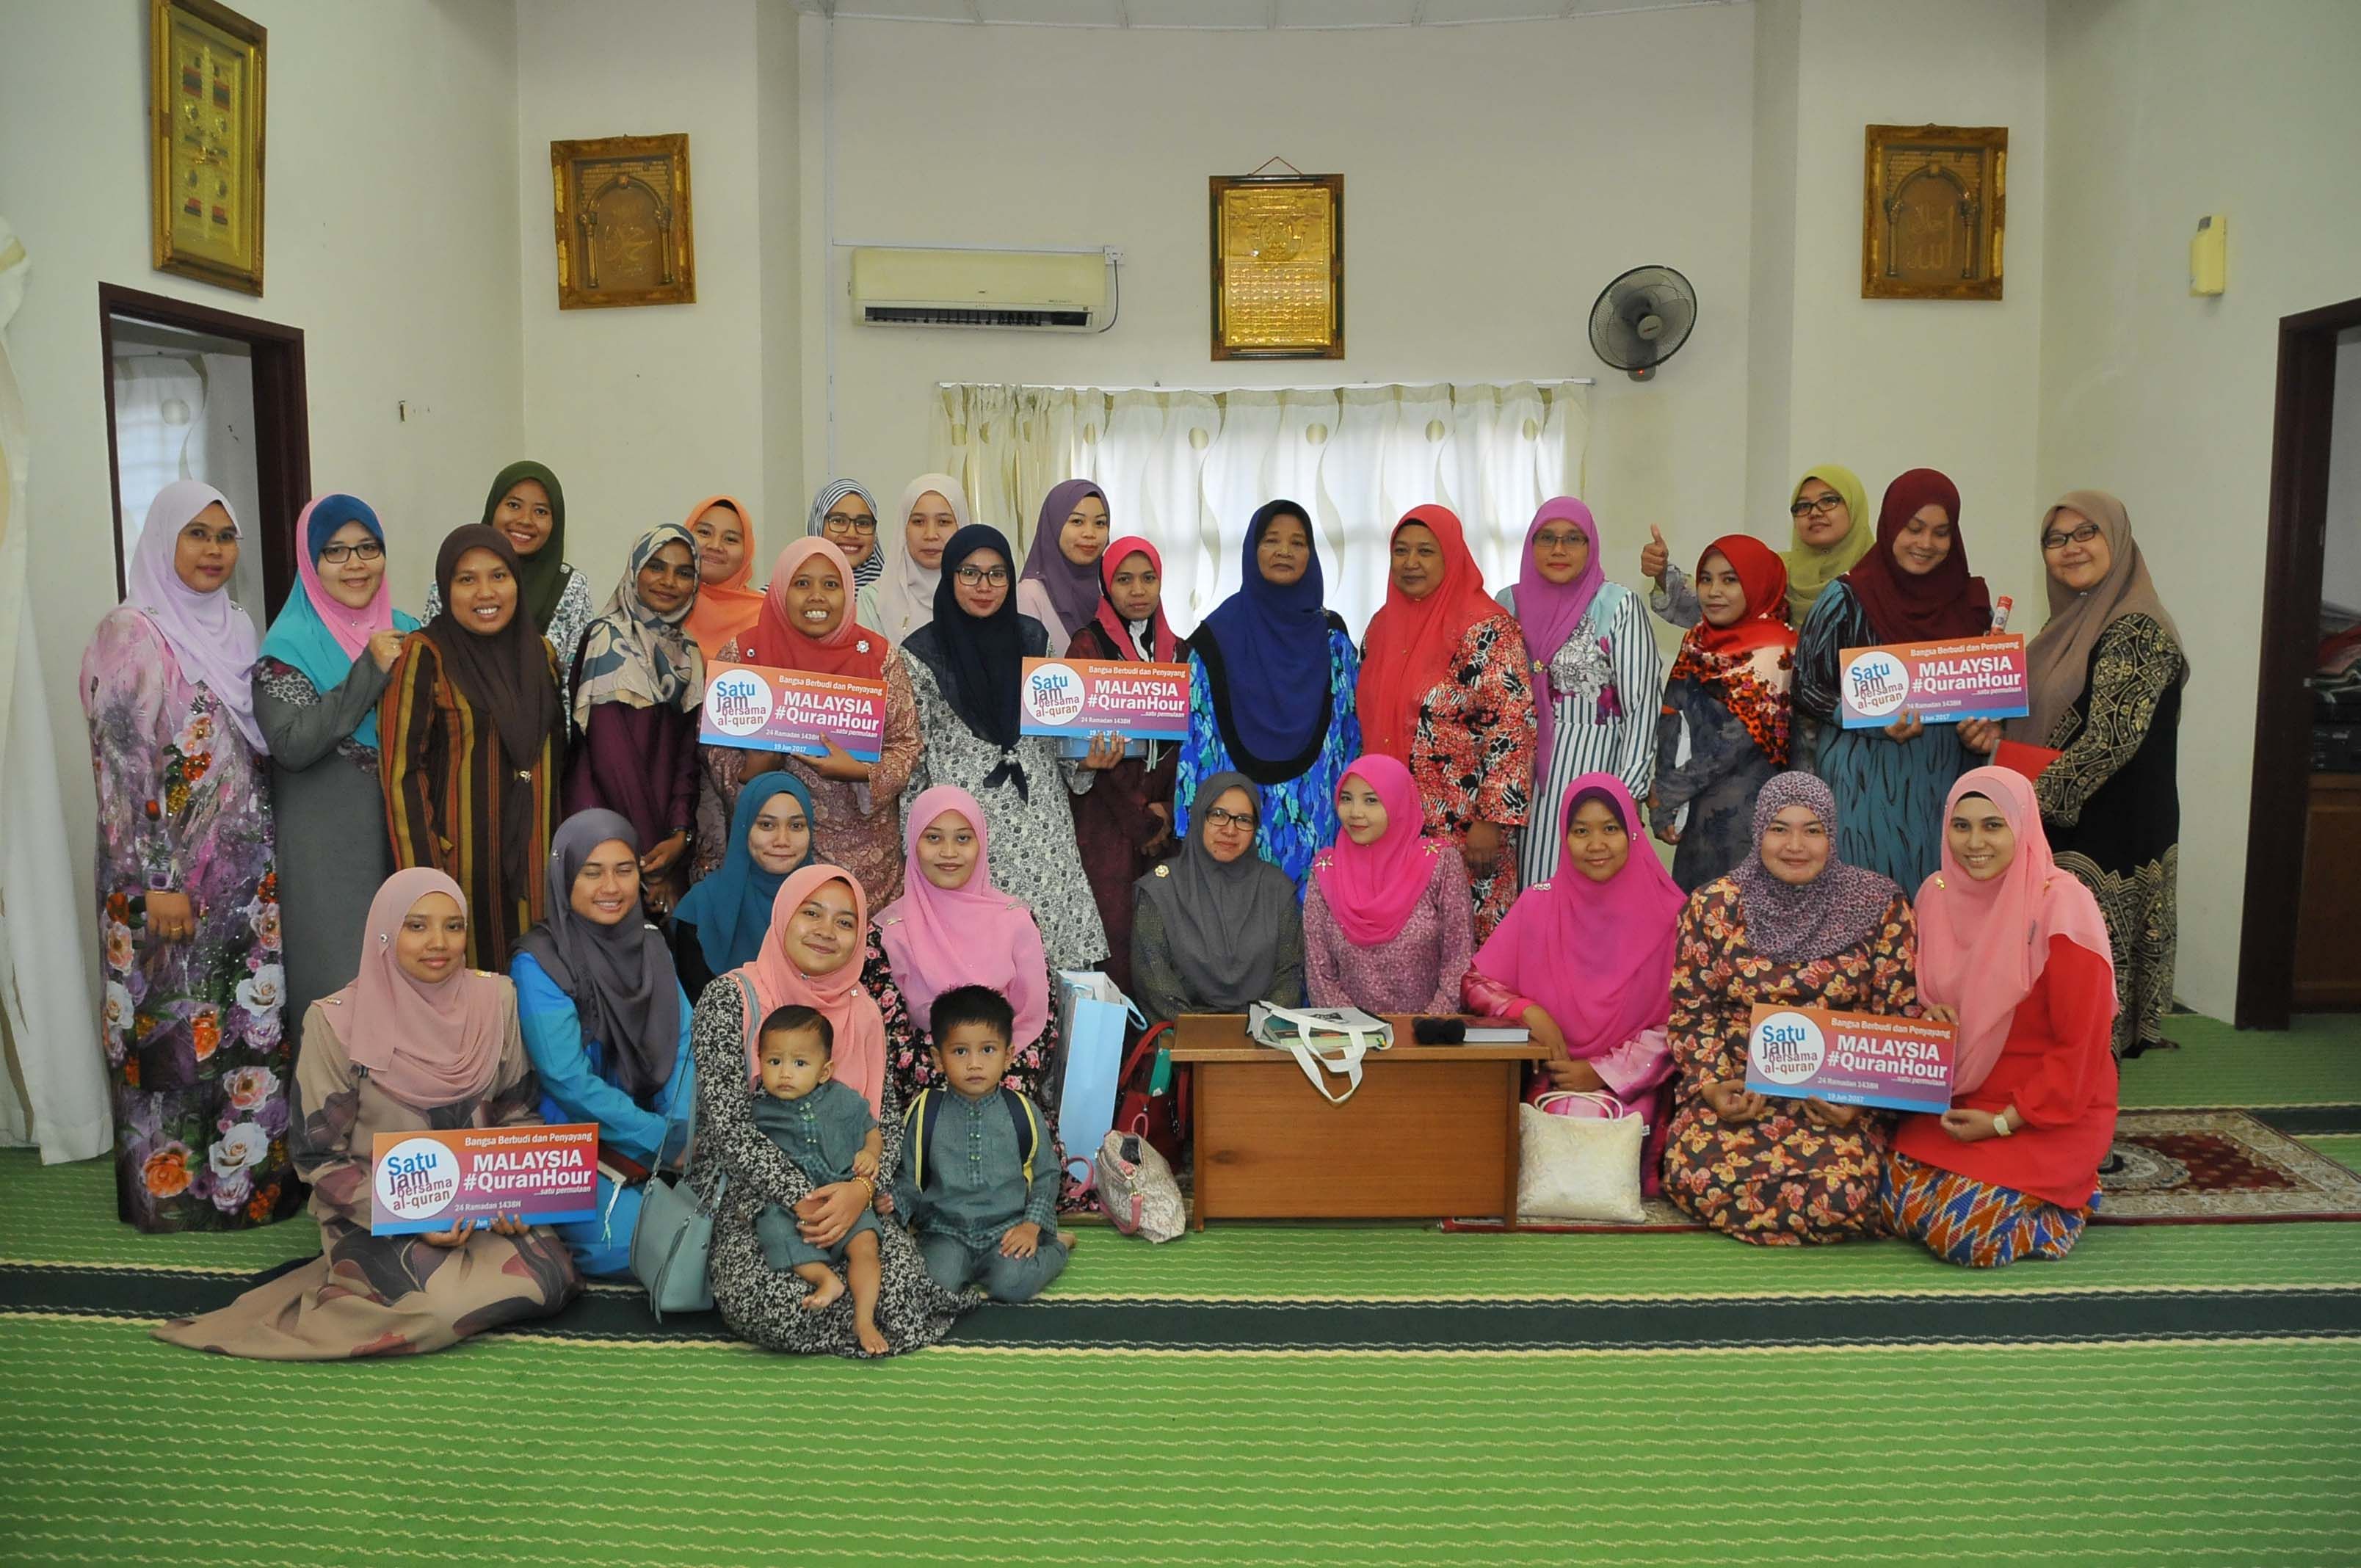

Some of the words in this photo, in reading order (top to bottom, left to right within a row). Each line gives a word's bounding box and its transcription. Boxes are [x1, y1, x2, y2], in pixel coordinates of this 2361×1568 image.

[1911, 649, 1936, 657] Bangsa
[1089, 666, 1111, 674] Bangsa
[1114, 667, 1138, 675] Berbudi
[1153, 668, 1185, 678] Penyayang
[1852, 663, 1890, 681] Satu
[1919, 656, 2012, 677] MALAYSIA
[717, 681, 755, 697] Satu
[779, 675, 804, 686] Bangsa
[806, 678, 832, 689] Berbudi
[833, 682, 846, 690] dan
[847, 683, 882, 695] Penyayang
[1032, 675, 1068, 690] Satu
[1095, 680, 1178, 697] MALAYSIA
[1854, 677, 1884, 697] jam
[1860, 682, 1903, 698] bersama
[1912, 673, 2020, 692] #QuranHour
[717, 695, 748, 713] jam
[784, 691, 873, 715] MALAYSIA
[1034, 687, 1062, 705] jam
[1039, 696, 1079, 708] bersama
[1088, 695, 1184, 711] #QuranHour
[1858, 692, 1902, 709] al-quran
[722, 705, 766, 716] bersama
[775, 705, 879, 730] #QuranHour
[1036, 705, 1078, 717] al-quran
[718, 715, 764, 726] al-quran
[1831, 1017, 1860, 1028] Bangsa
[1893, 1023, 1908, 1032] dan
[1763, 1026, 1805, 1042] Satu
[1763, 1040, 1797, 1059] jam
[1837, 1035, 1940, 1061] MALAYSIA
[1769, 1052, 1818, 1063] bersama
[1827, 1051, 1947, 1079] #QuranHour
[1764, 1063, 1815, 1074] al-quran
[465, 1137, 496, 1147] Bangsa
[498, 1135, 530, 1145] Berbudi
[532, 1134, 548, 1142] dan
[549, 1132, 592, 1142] Penyayang
[387, 1151, 437, 1175] Satu
[474, 1149, 583, 1172] MALAYSIA
[390, 1169, 429, 1196] jam
[397, 1178, 452, 1197] bersama
[464, 1169, 591, 1192] #QuranHour
[394, 1190, 450, 1211] al-quran
